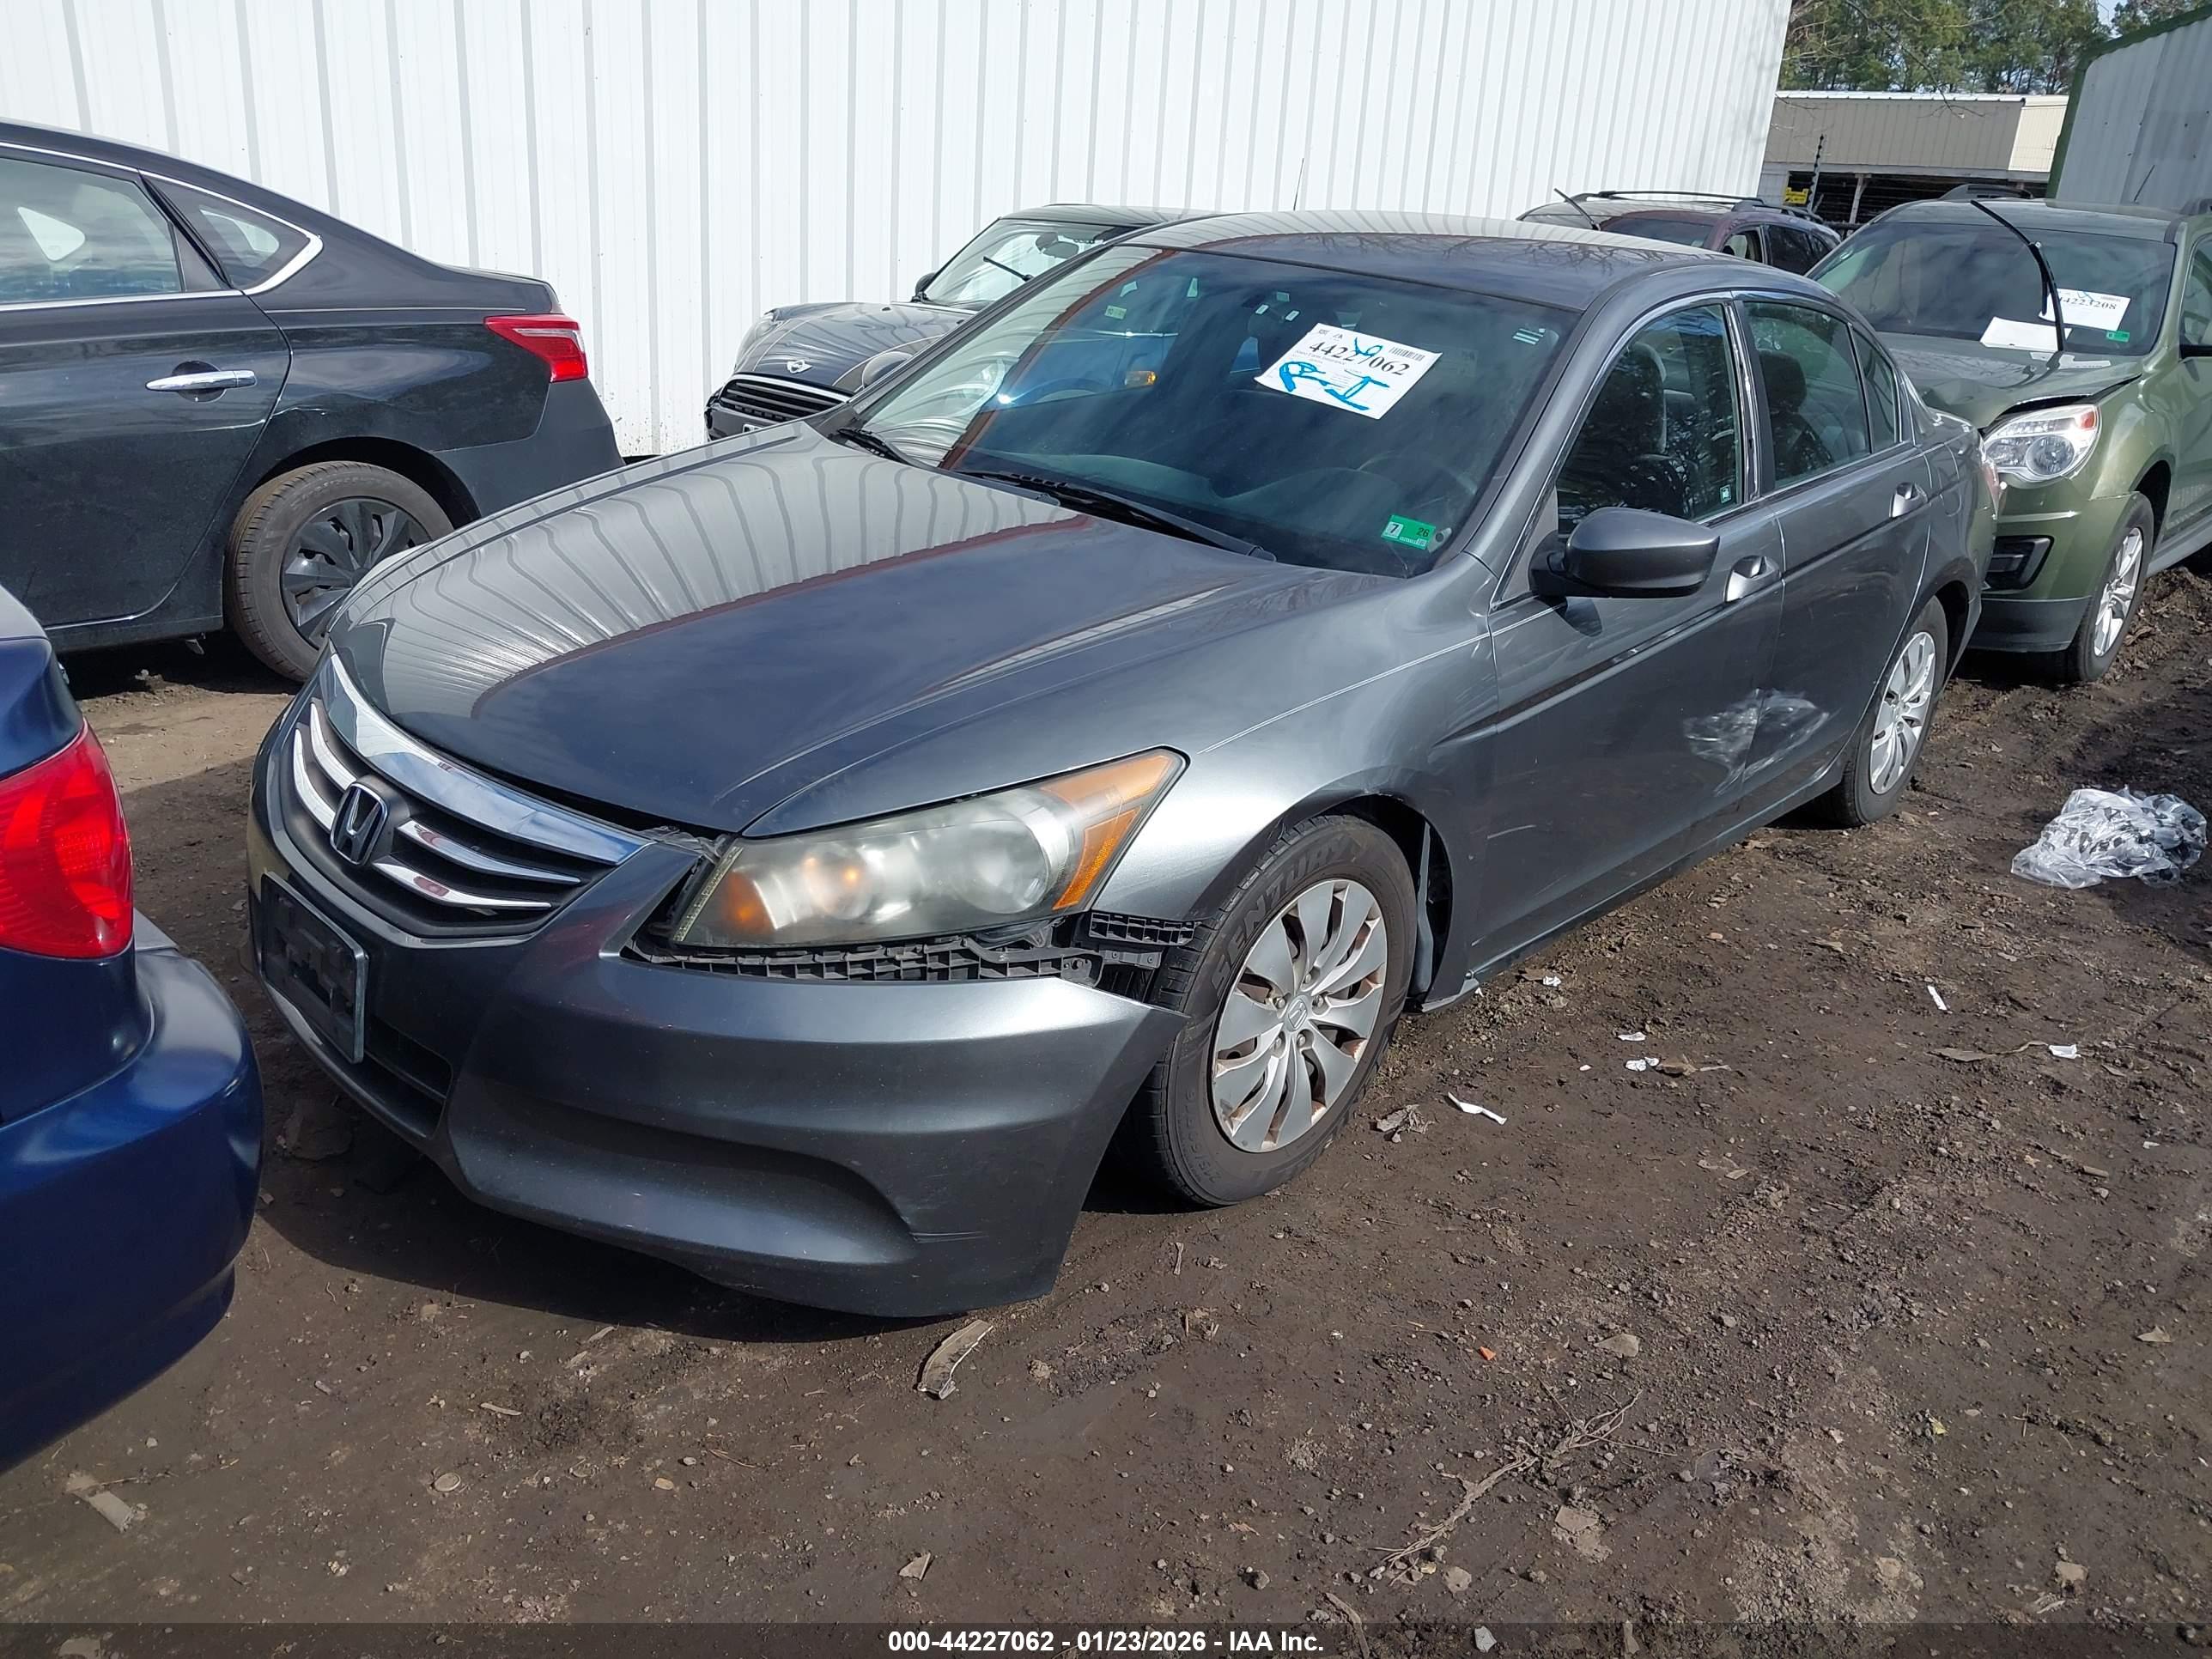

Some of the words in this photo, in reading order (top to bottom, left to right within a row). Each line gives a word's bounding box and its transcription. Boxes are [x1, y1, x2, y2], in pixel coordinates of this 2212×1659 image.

[1309, 341, 1410, 376] 44227062
[1390, 523, 1400, 534] 7
[1416, 527, 1431, 538] 26
